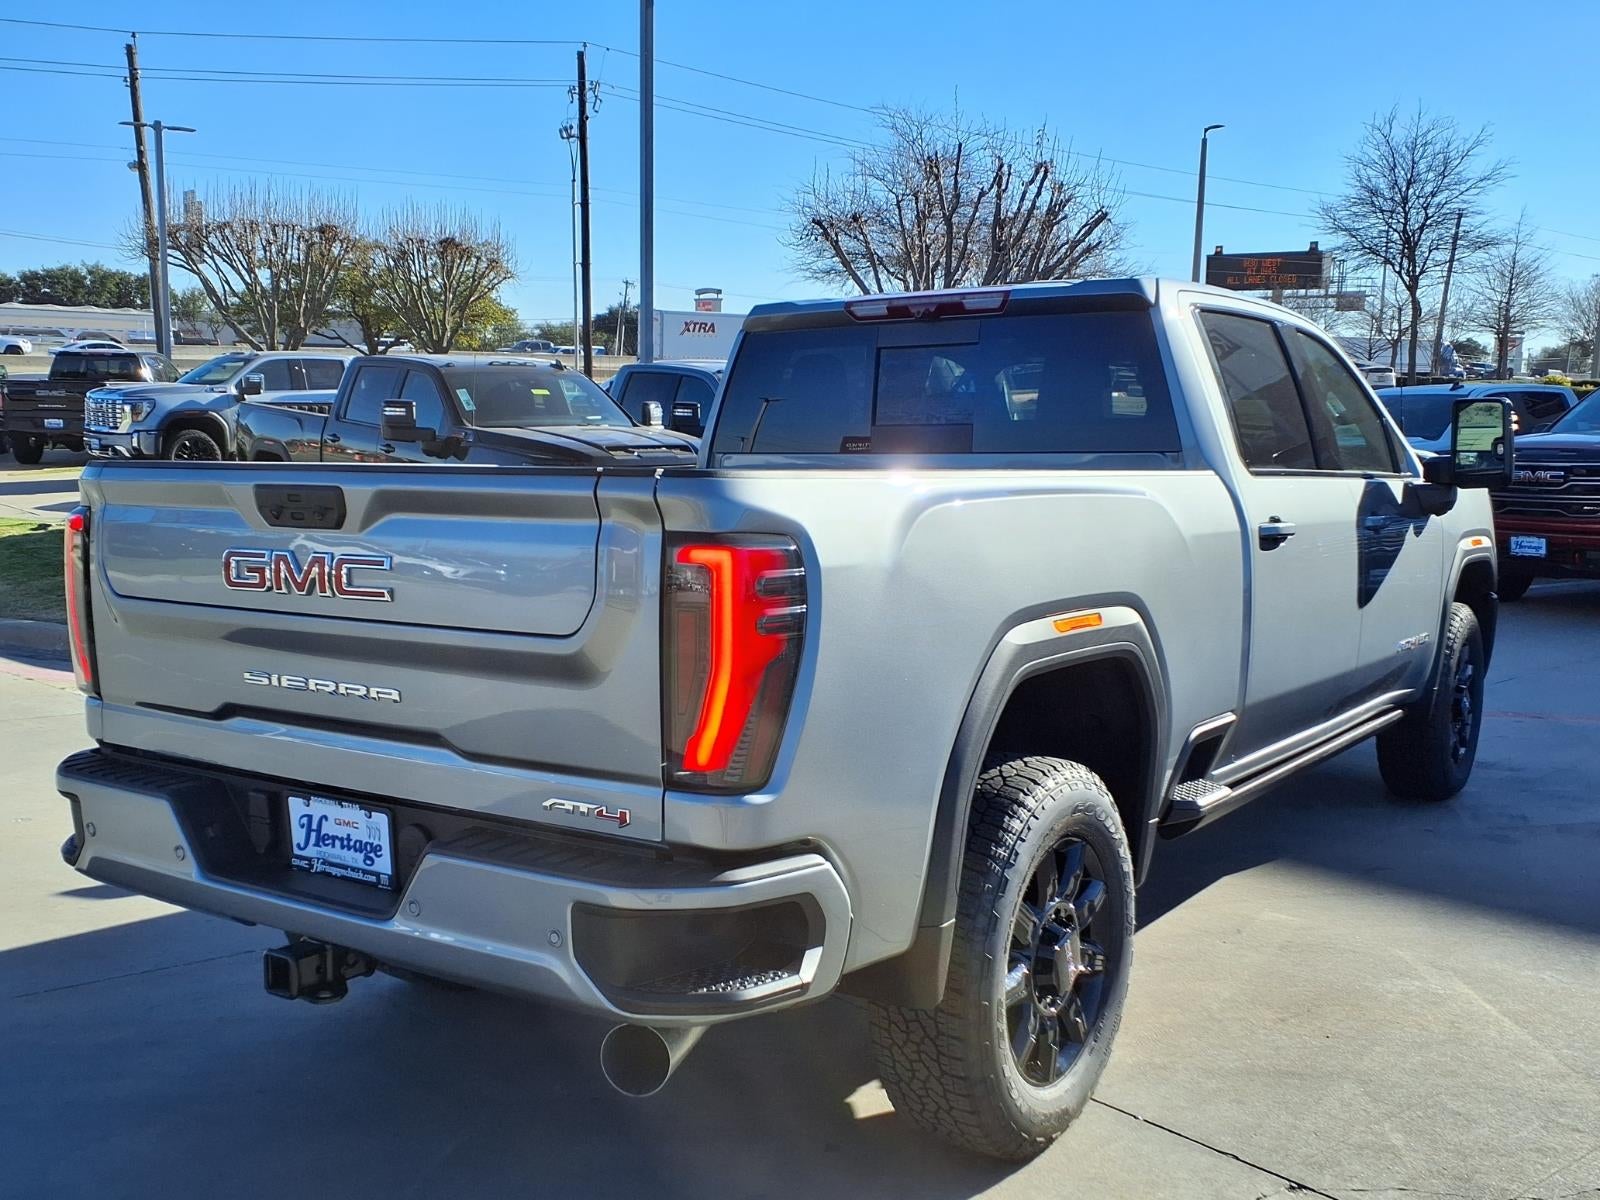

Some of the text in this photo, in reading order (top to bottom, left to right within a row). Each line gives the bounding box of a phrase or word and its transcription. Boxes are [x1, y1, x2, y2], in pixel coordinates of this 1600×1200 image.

[1261, 258, 1280, 267] WEST
[1226, 274, 1297, 285] ALL LANES CLOSED
[679, 320, 716, 336] XTRA
[222, 547, 394, 603] GMC
[243, 670, 402, 703] SIERRA
[334, 818, 360, 830] GMC
[542, 798, 632, 828] AT4
[296, 813, 383, 867] Heritage
